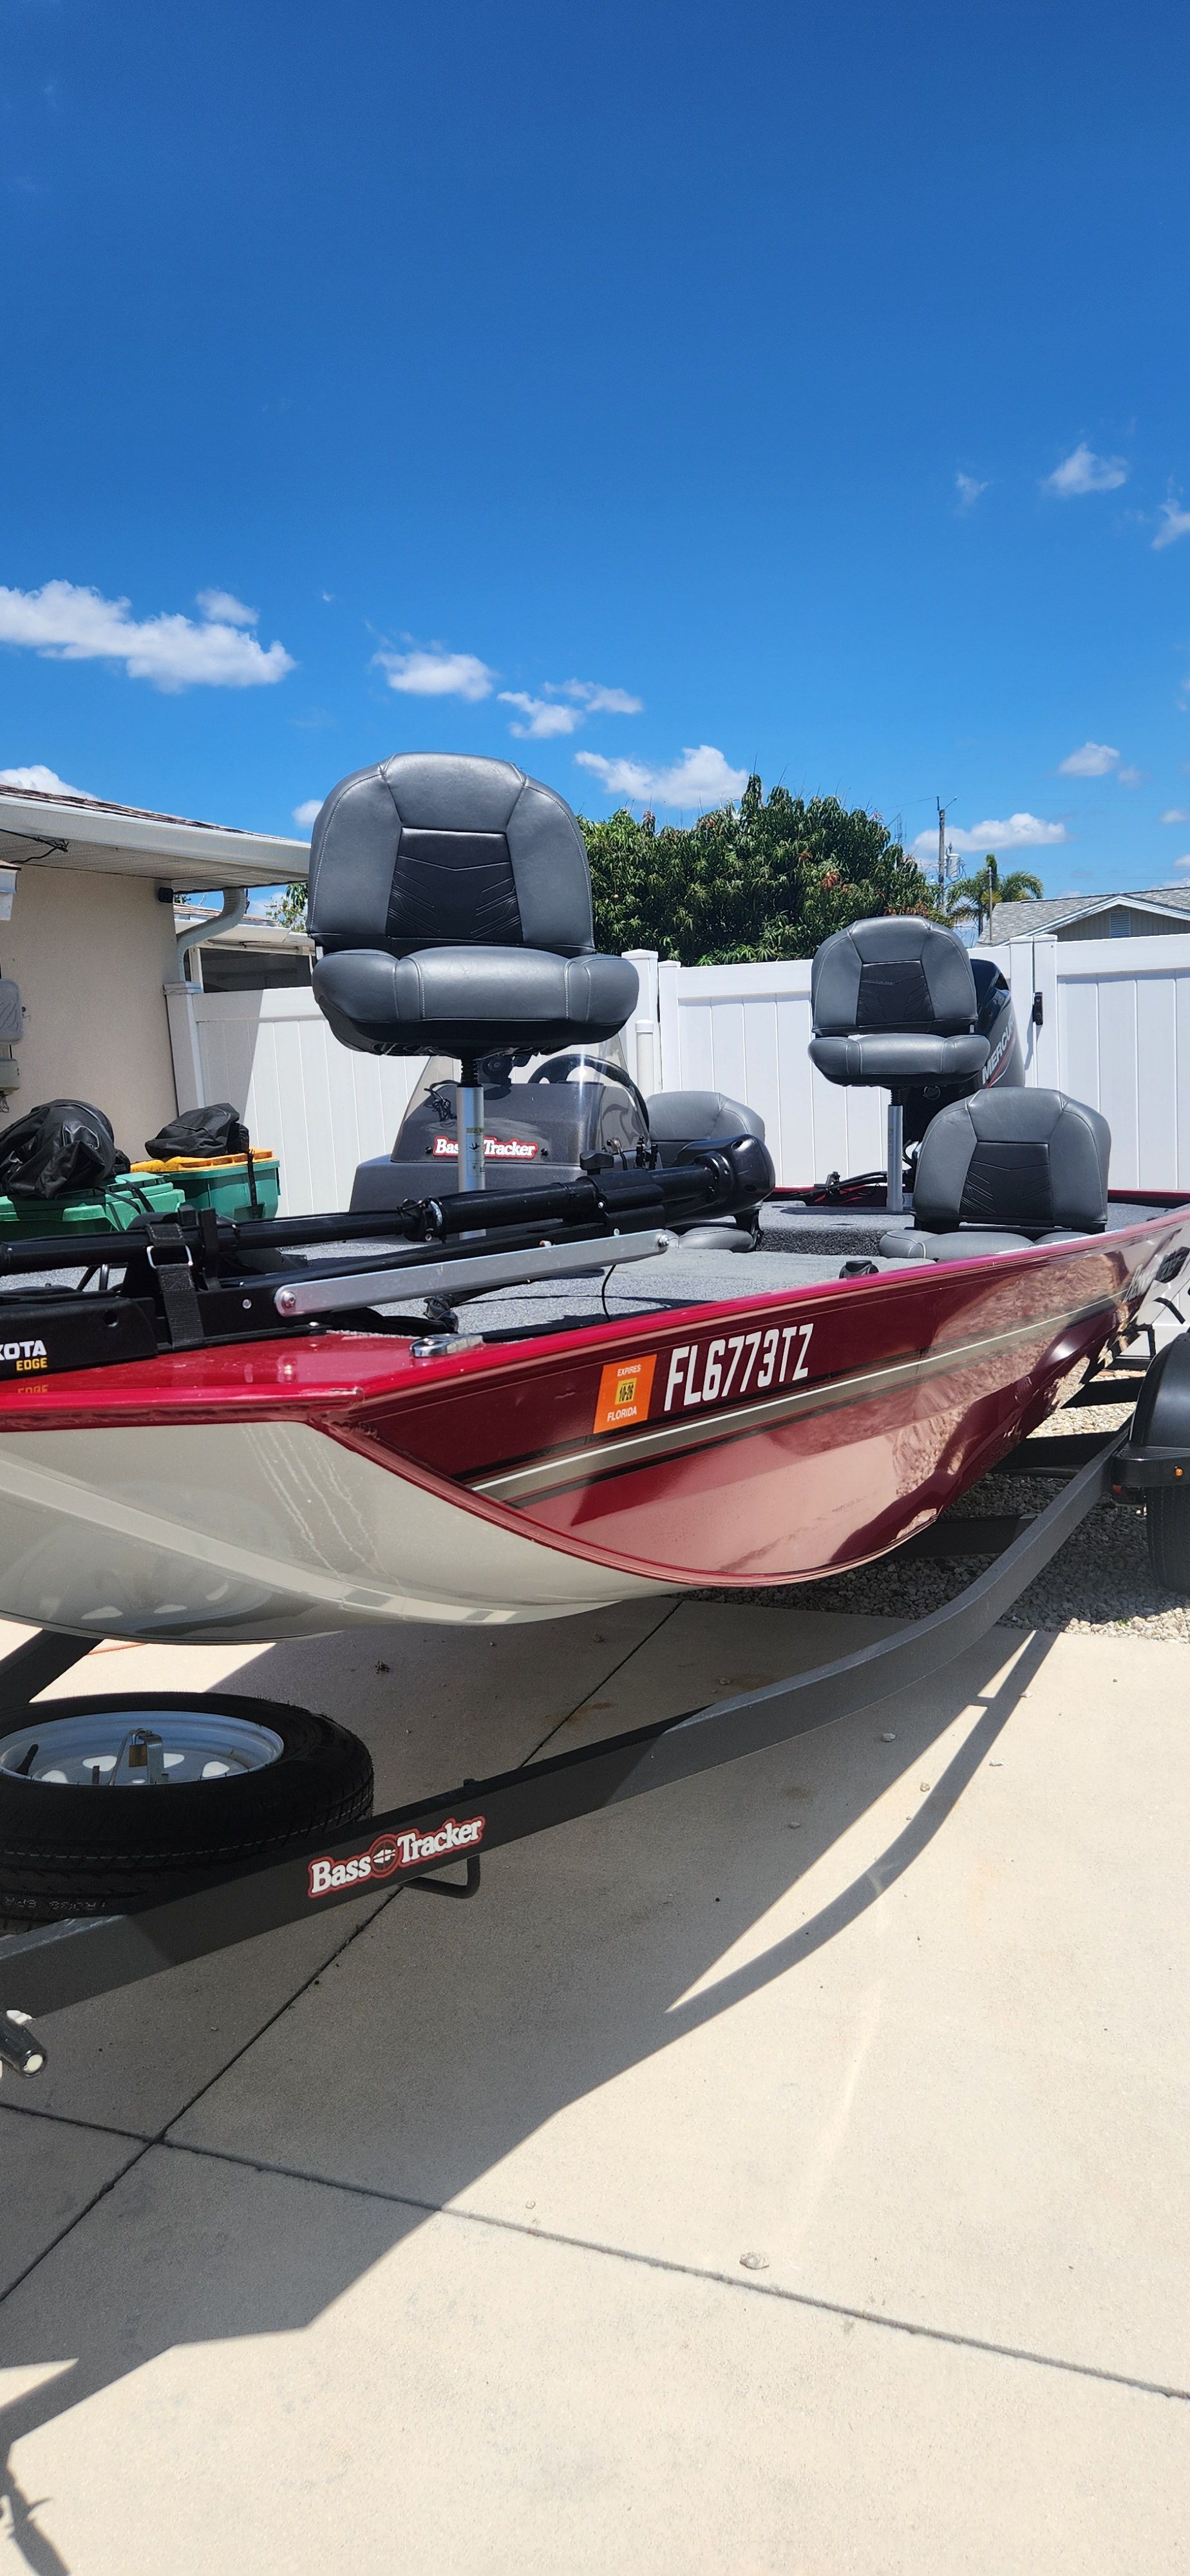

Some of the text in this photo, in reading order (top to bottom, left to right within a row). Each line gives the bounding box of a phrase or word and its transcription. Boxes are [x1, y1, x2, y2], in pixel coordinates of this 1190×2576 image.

[435, 1139, 536, 1156] Bas Tracker
[16, 1357, 48, 1371] EDGE
[617, 1364, 641, 1377] EXPIRES
[664, 1323, 813, 1411] FL6773TZ
[607, 1406, 638, 1422] FLORIDA
[312, 1820, 482, 1893] Bass Tracker
